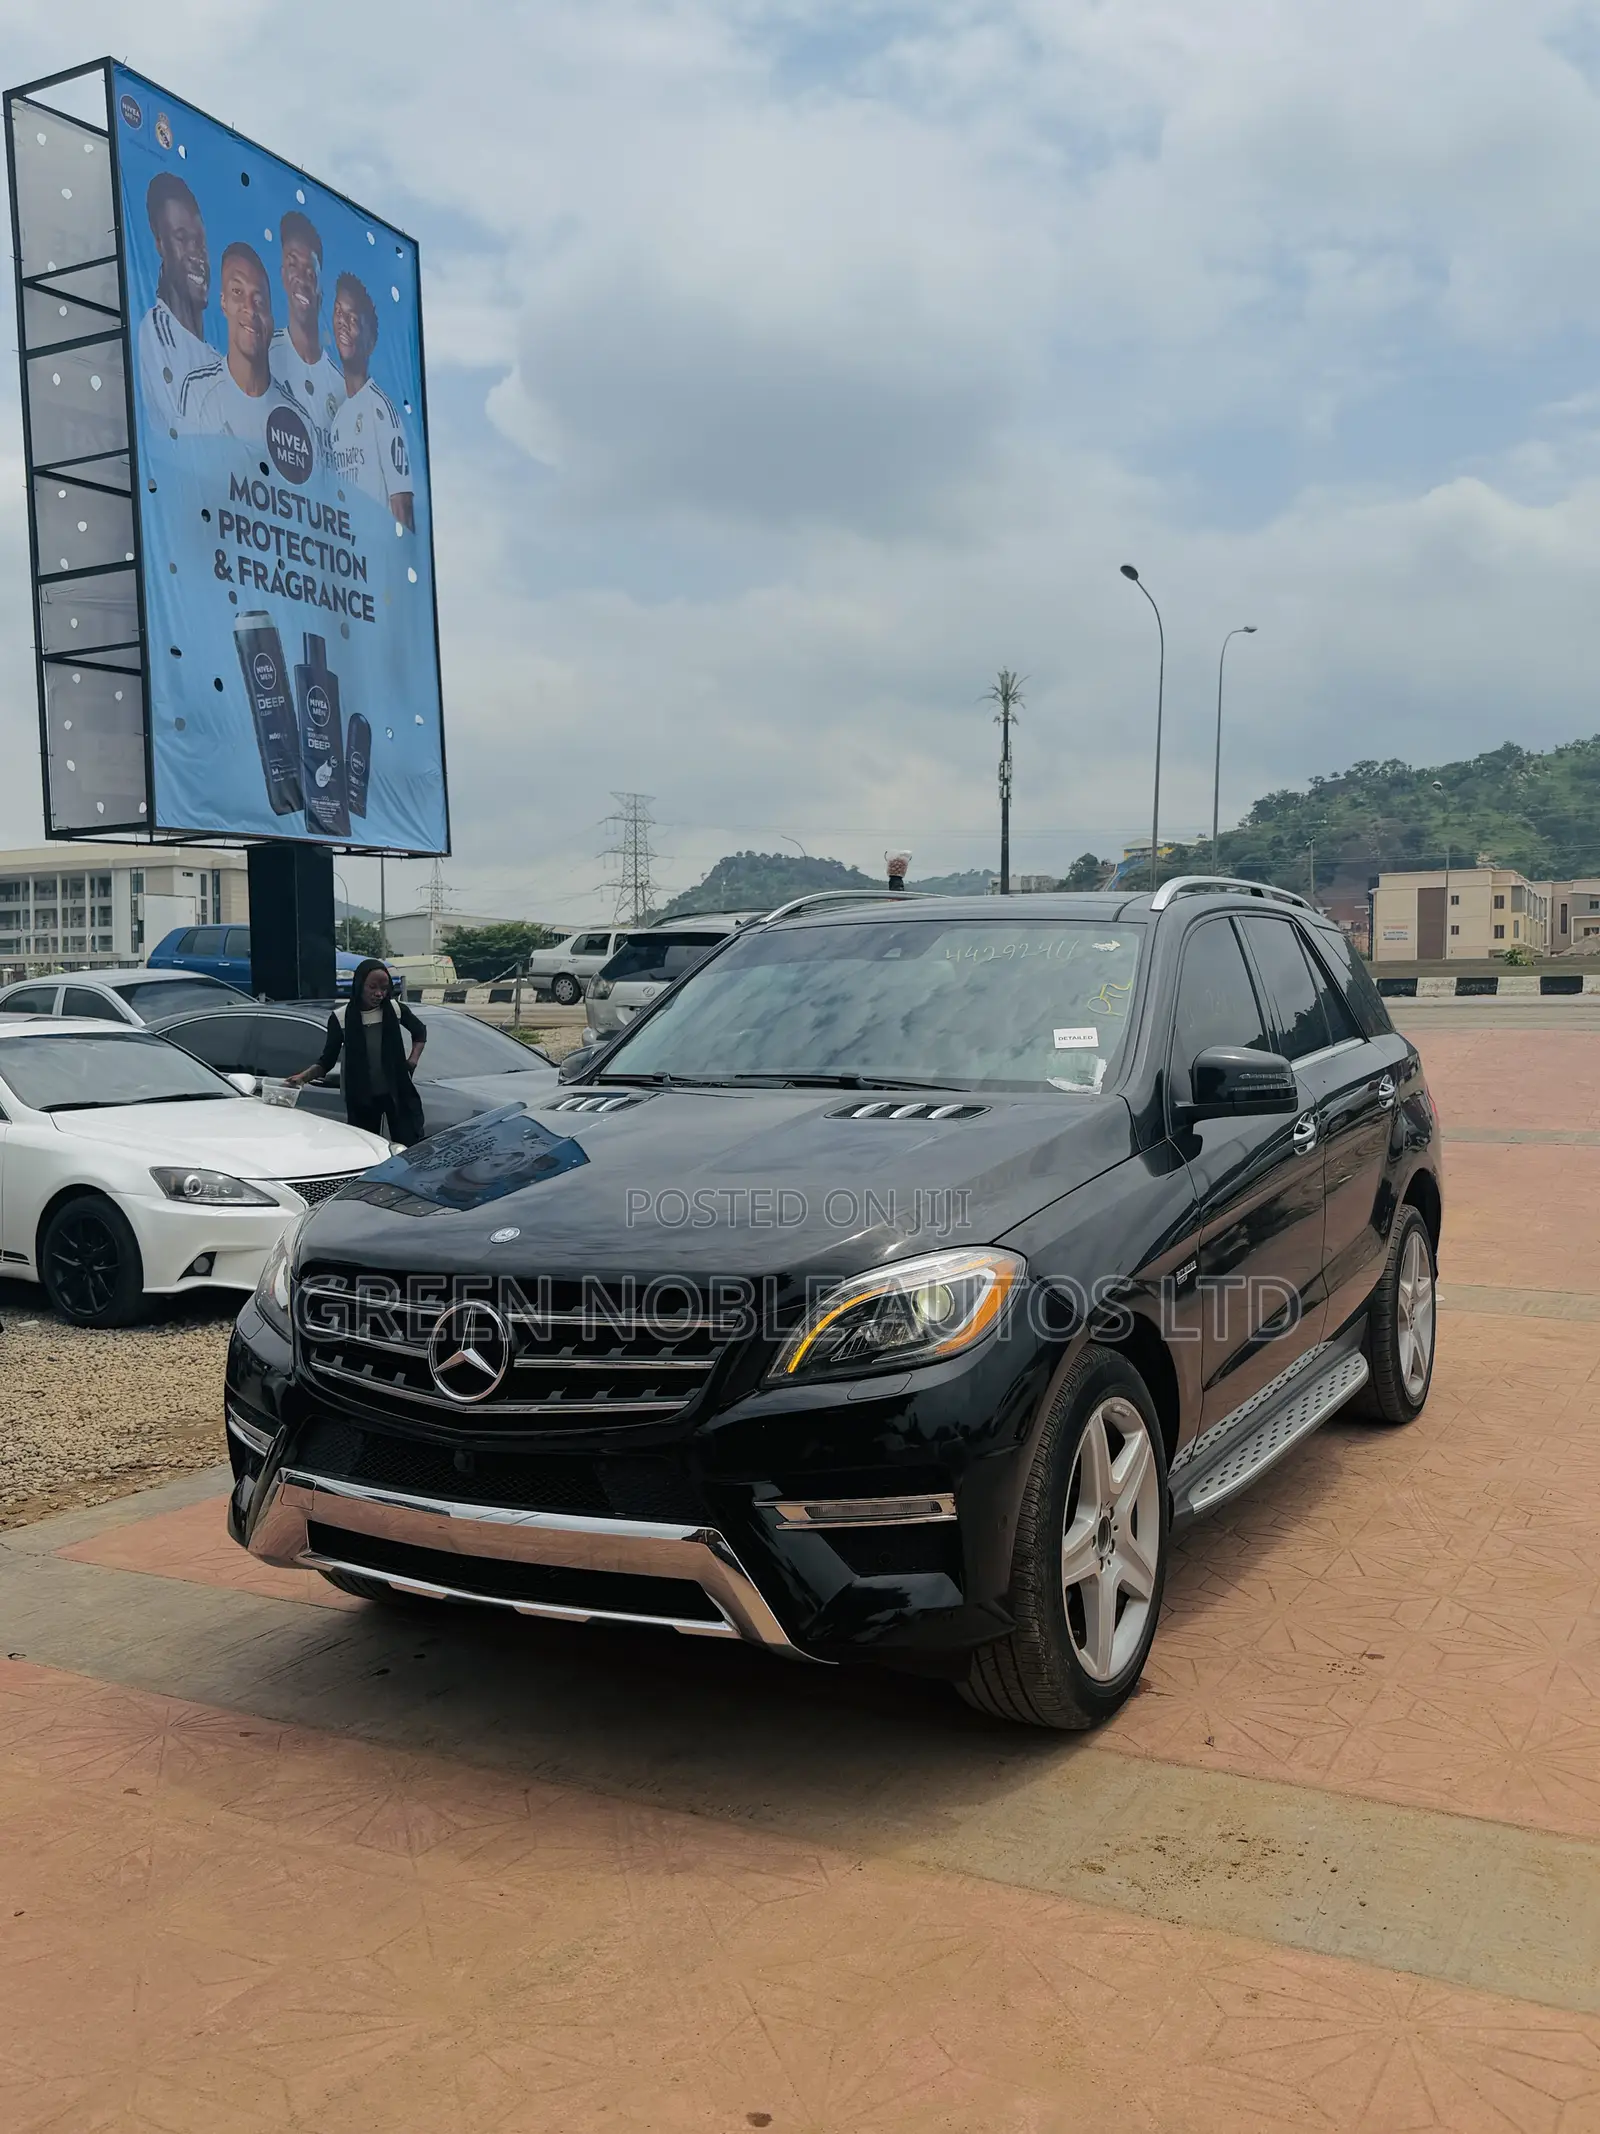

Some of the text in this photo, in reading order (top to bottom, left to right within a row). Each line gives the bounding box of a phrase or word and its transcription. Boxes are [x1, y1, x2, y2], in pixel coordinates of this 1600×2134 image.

[270, 426, 310, 456] NIVEA
[276, 447, 306, 469] MEN
[229, 471, 356, 547] MOISTURE,
[218, 508, 368, 584] PROTECTION
[214, 548, 376, 623] & FRAGRANCE
[256, 665, 274, 674] NIVEA
[257, 696, 285, 710] DEEP
[309, 698, 328, 710] NIVEA
[312, 707, 326, 717] MEN
[308, 738, 331, 750] DEEP
